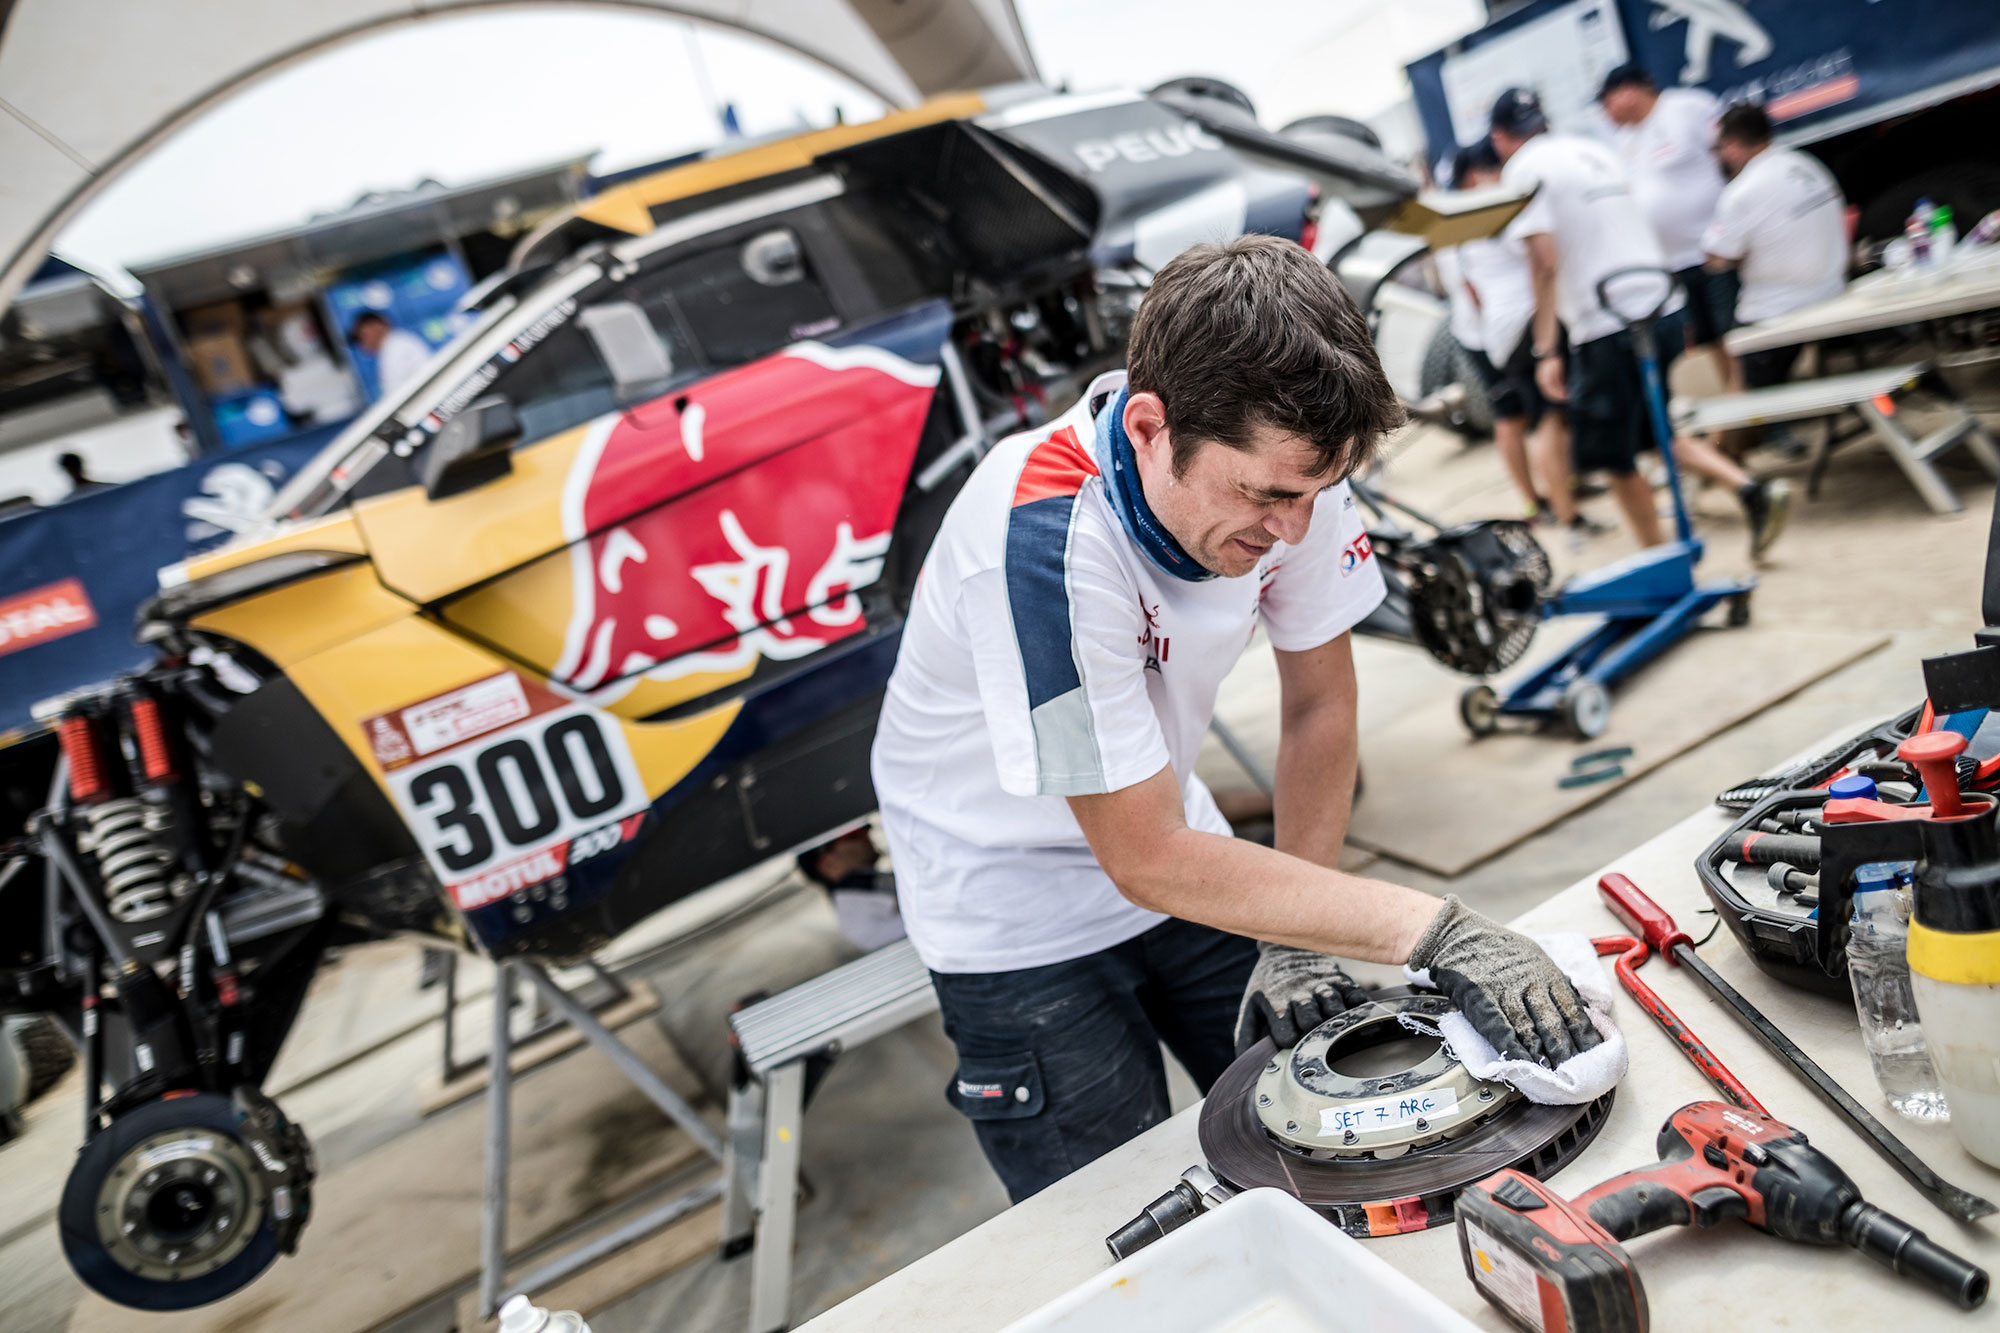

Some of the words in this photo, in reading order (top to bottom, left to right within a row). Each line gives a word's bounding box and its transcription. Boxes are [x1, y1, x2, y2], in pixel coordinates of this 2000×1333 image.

[410, 714, 624, 871] 300
[456, 853, 564, 908] MOTUL
[1334, 1110, 1364, 1130] SET
[1374, 1107, 1390, 1122] 7
[1399, 1097, 1436, 1119] ARG
